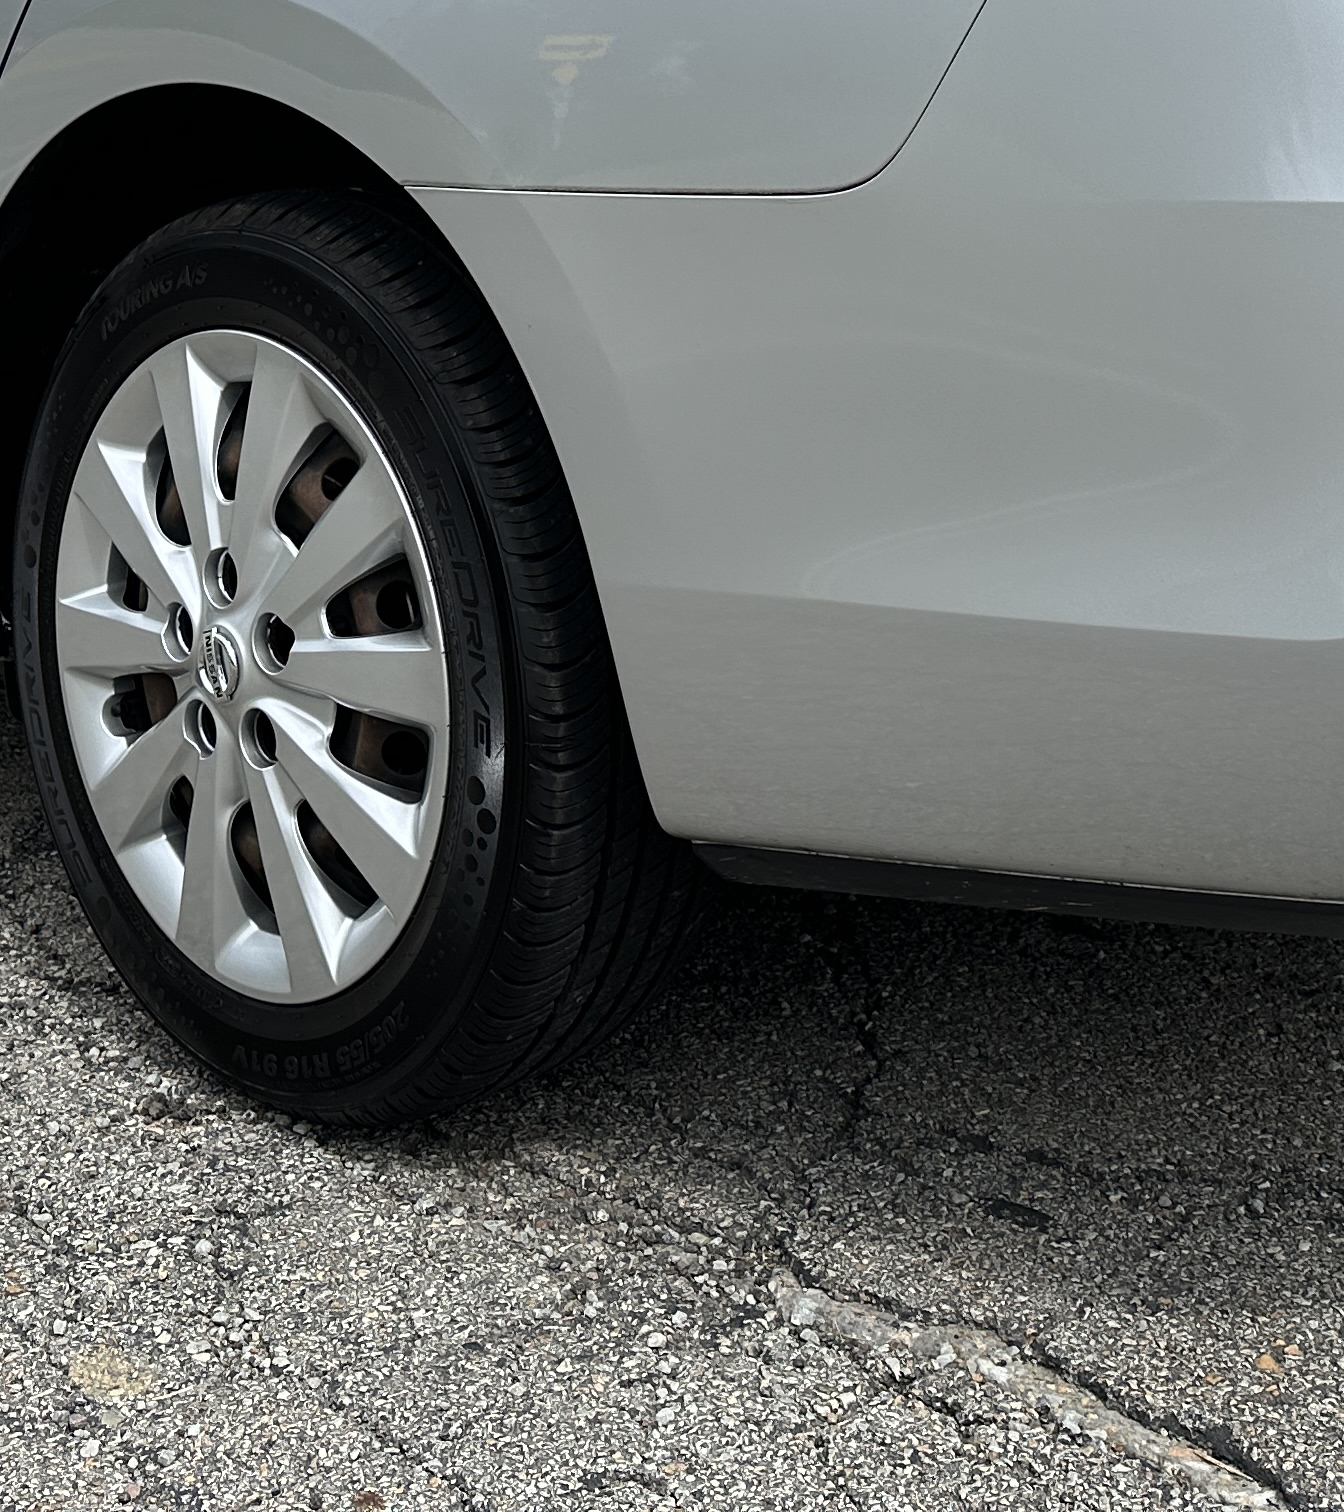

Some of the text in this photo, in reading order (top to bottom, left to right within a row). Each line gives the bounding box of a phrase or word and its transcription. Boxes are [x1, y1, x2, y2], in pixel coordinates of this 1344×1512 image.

[101, 263, 209, 341] TOURING A/S
[204, 634, 224, 698] NISSAN
[232, 1044, 278, 1078] 91V
[284, 1052, 331, 1080] R16
[335, 1000, 409, 1072] 205/55
